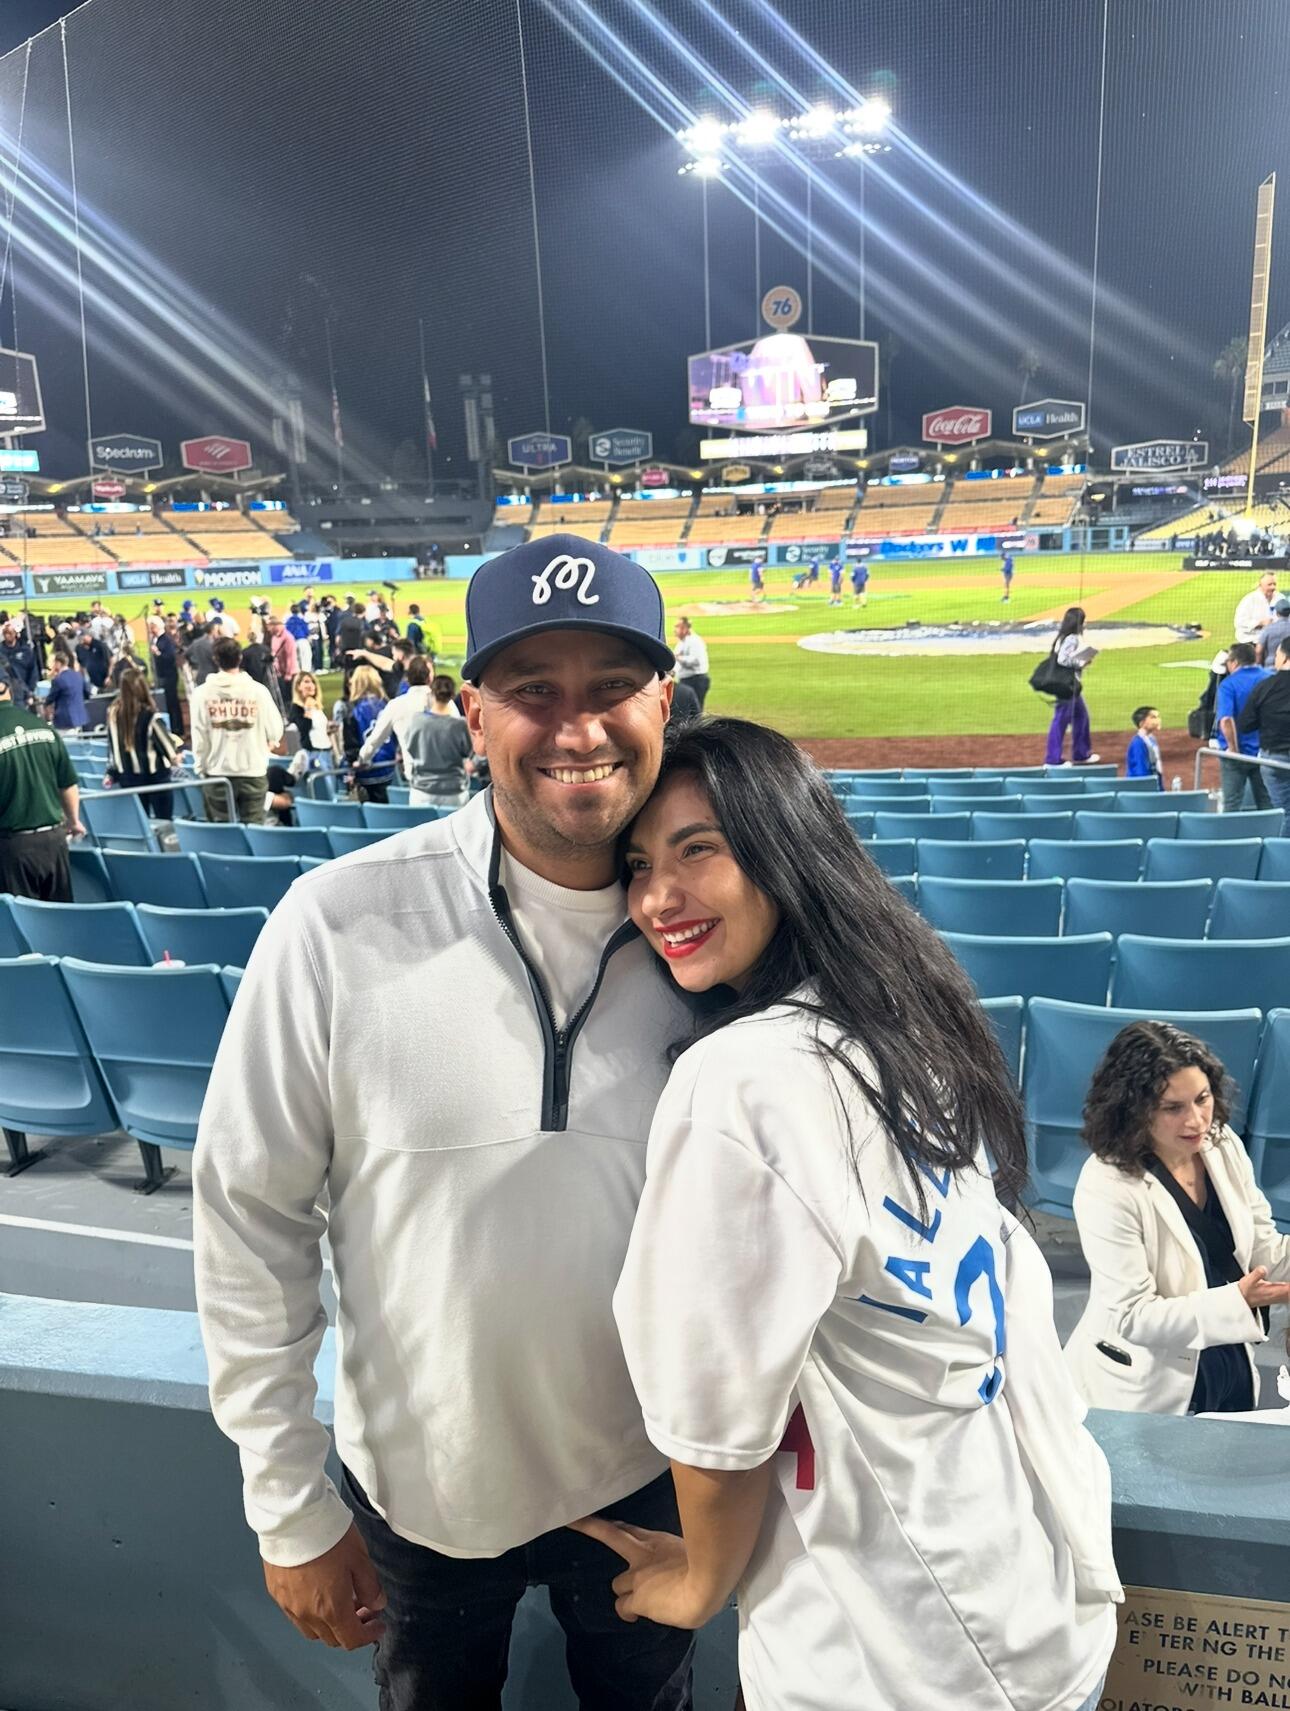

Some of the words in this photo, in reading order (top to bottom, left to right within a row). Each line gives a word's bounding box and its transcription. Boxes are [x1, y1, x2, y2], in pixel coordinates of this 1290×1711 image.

[772, 298, 793, 316] 76
[1018, 414, 1041, 426] UCLA
[1046, 412, 1079, 425] Health
[96, 446, 154, 460] Spectrum
[521, 442, 557, 453] ULTRA
[1120, 455, 1181, 468] JALISCO
[151, 572, 182, 585] Health
[205, 571, 261, 587] MORTON
[208, 706, 258, 718] RHUDE
[1173, 1616, 1198, 1632] BE
[1206, 1620, 1270, 1641] ALERT
[1246, 1643, 1286, 1662] THE
[1144, 1658, 1218, 1682] PLEASE
[1227, 1669, 1260, 1686] DO
[1269, 1673, 1290, 1690] N
[1178, 1681, 1232, 1702] WITH
